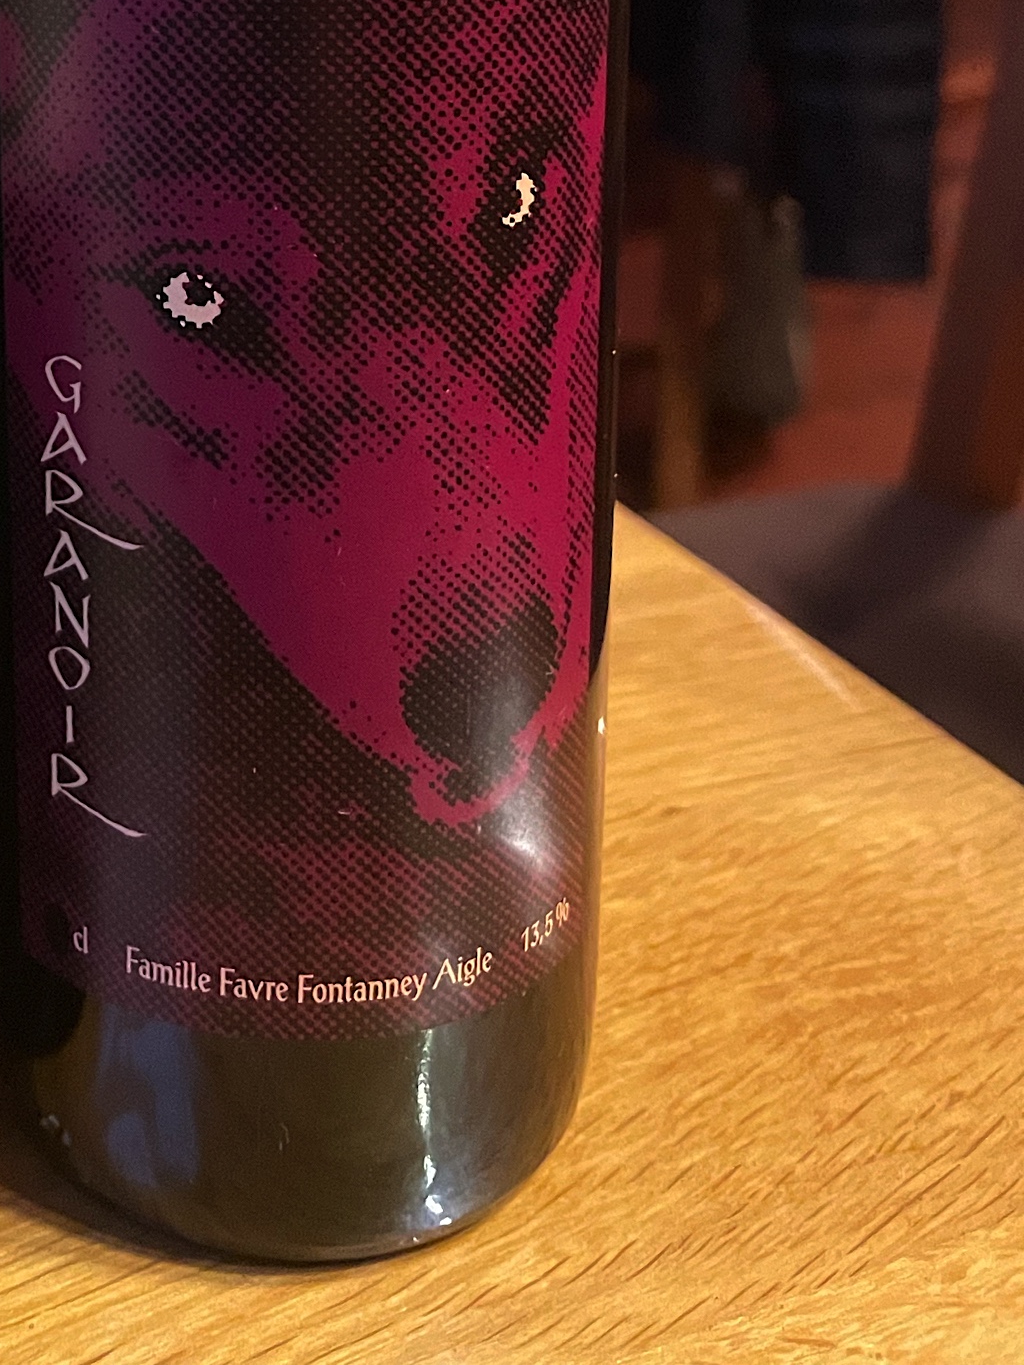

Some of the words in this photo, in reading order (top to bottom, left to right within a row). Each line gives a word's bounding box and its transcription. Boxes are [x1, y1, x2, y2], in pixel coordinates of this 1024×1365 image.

[39, 354, 148, 839] GARANOIR
[125, 944, 212, 994] Famille
[218, 967, 289, 1003] Favre
[297, 970, 428, 1005] Fontanney
[432, 947, 494, 991] Aigle
